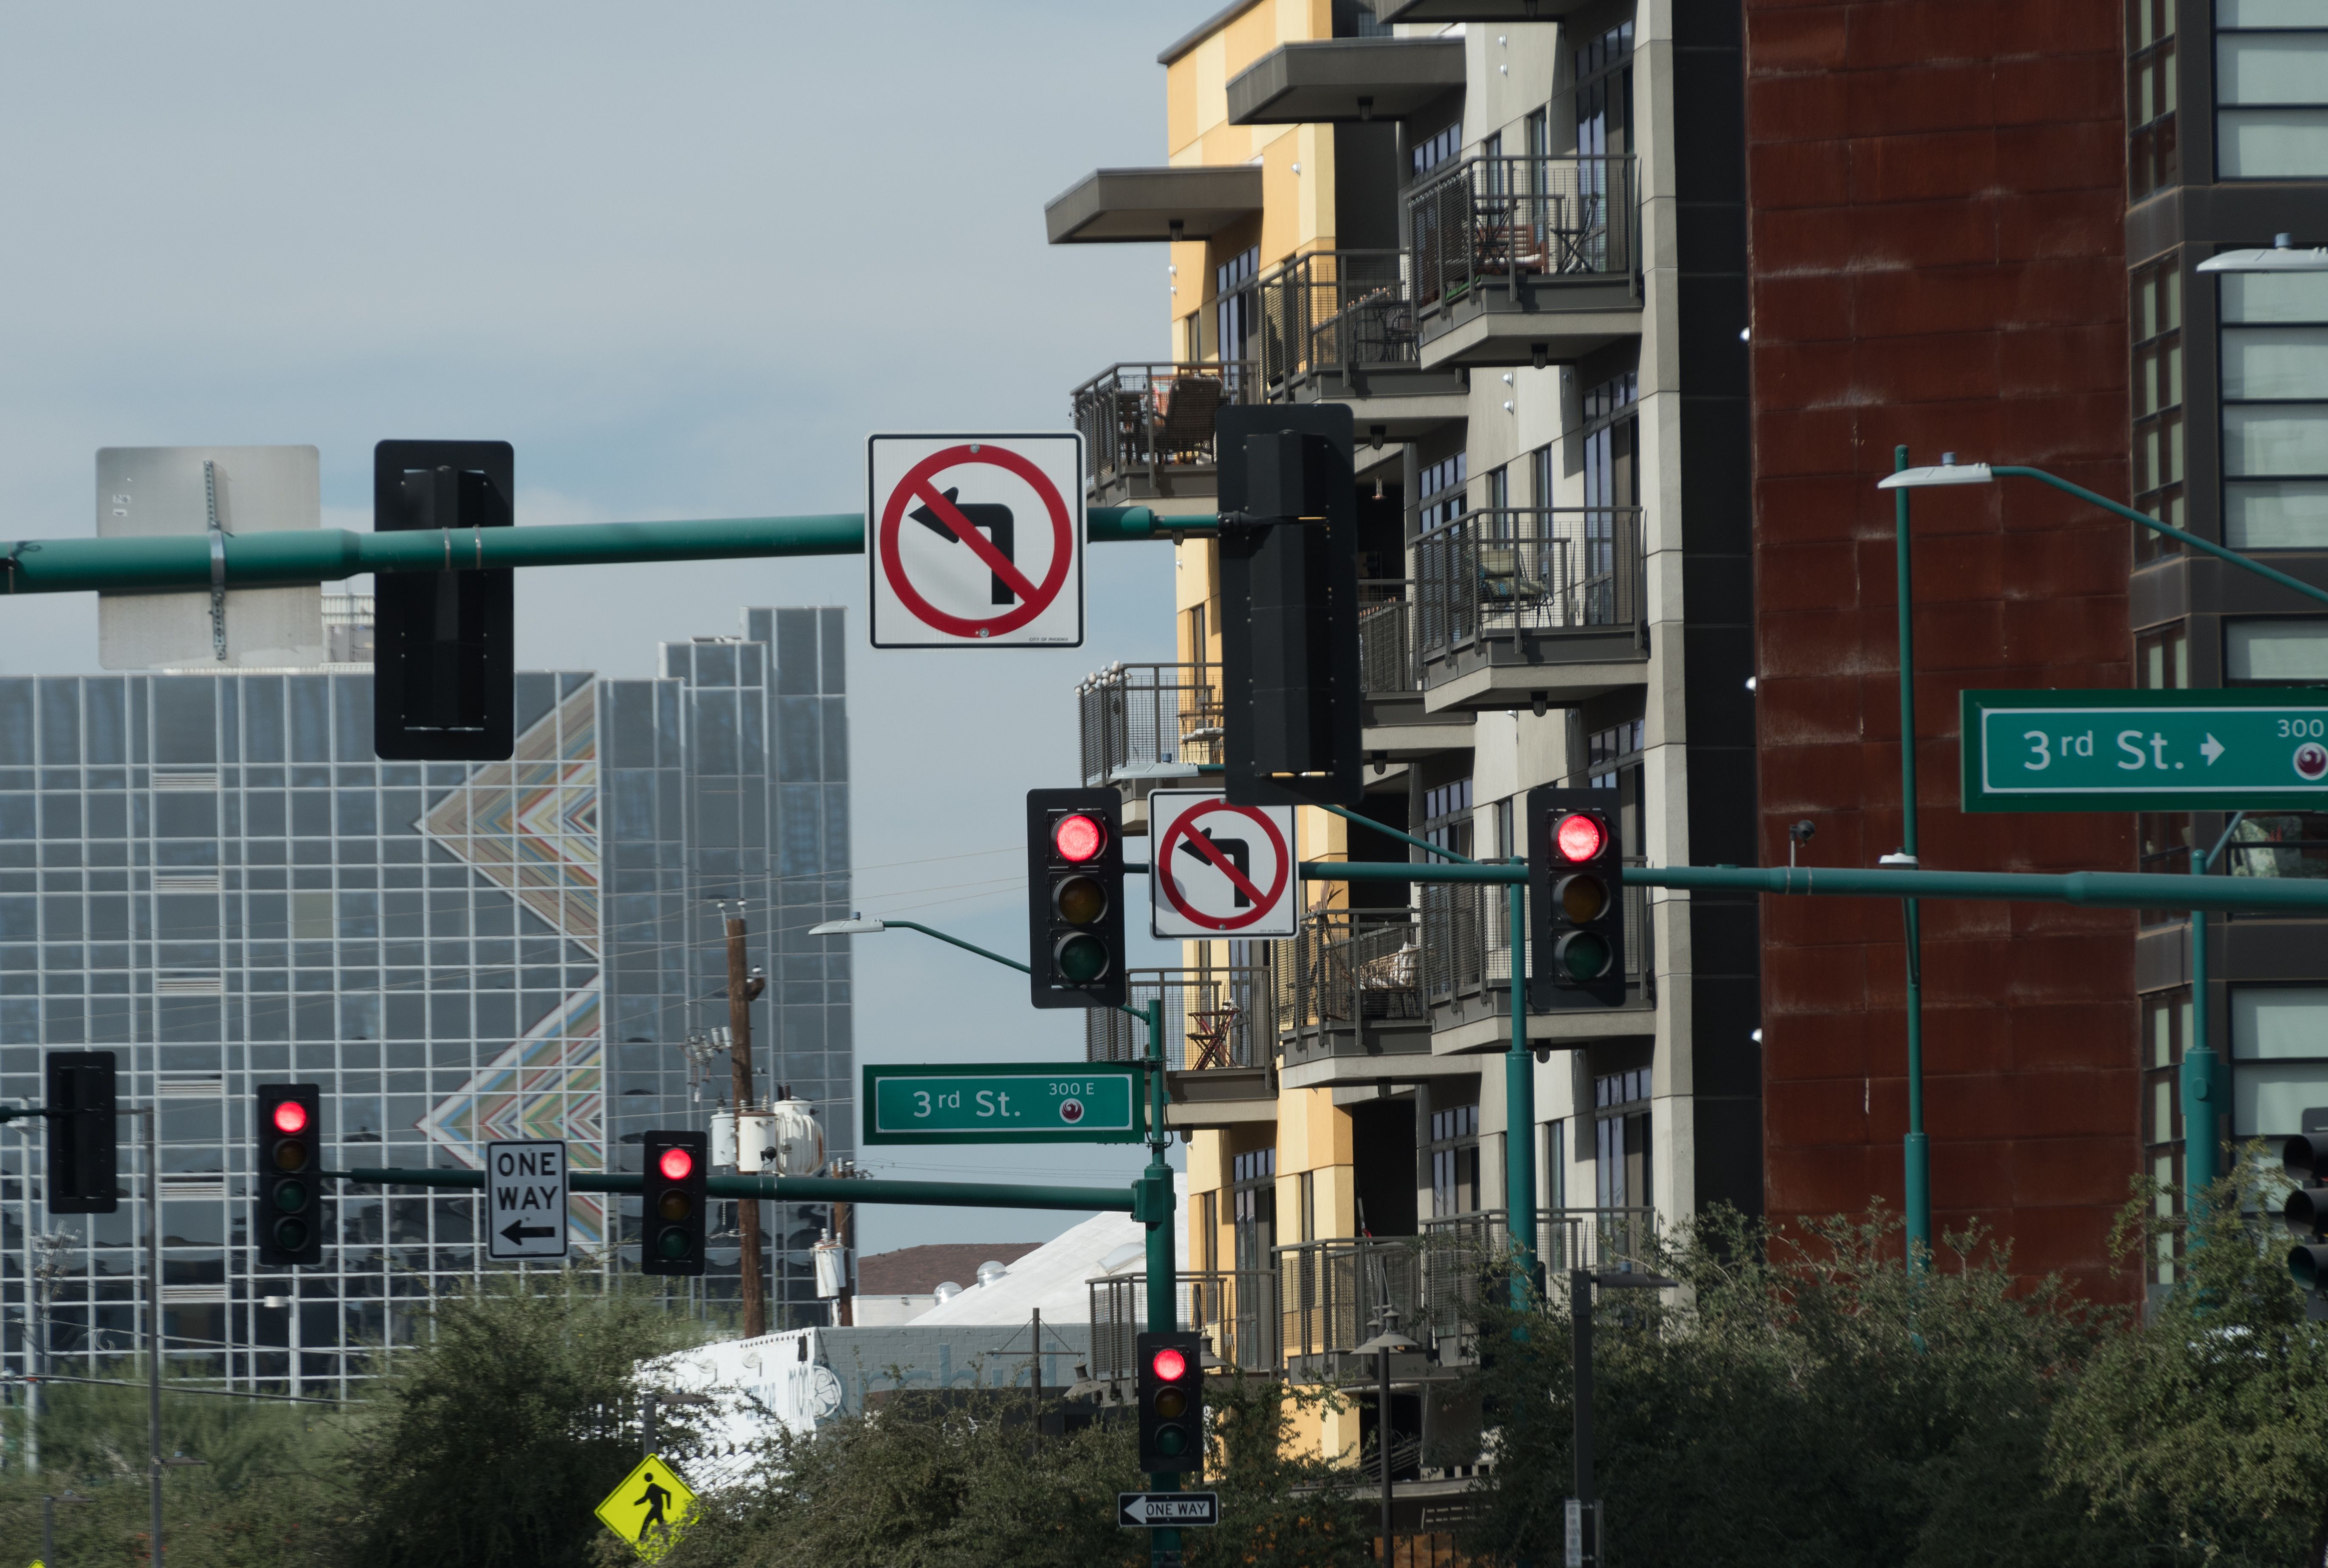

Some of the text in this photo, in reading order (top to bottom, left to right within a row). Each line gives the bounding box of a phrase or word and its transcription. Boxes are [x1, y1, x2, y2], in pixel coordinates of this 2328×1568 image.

[2277, 719, 2325, 738] 300
[2024, 730, 2184, 770] 3rd St.
[1049, 1083, 1094, 1095] 300 E
[913, 1090, 1020, 1117] 3rd St.
[497, 1152, 556, 1176] ONE
[497, 1186, 558, 1210] WAY
[1147, 1503, 1205, 1515] ONE WAY
